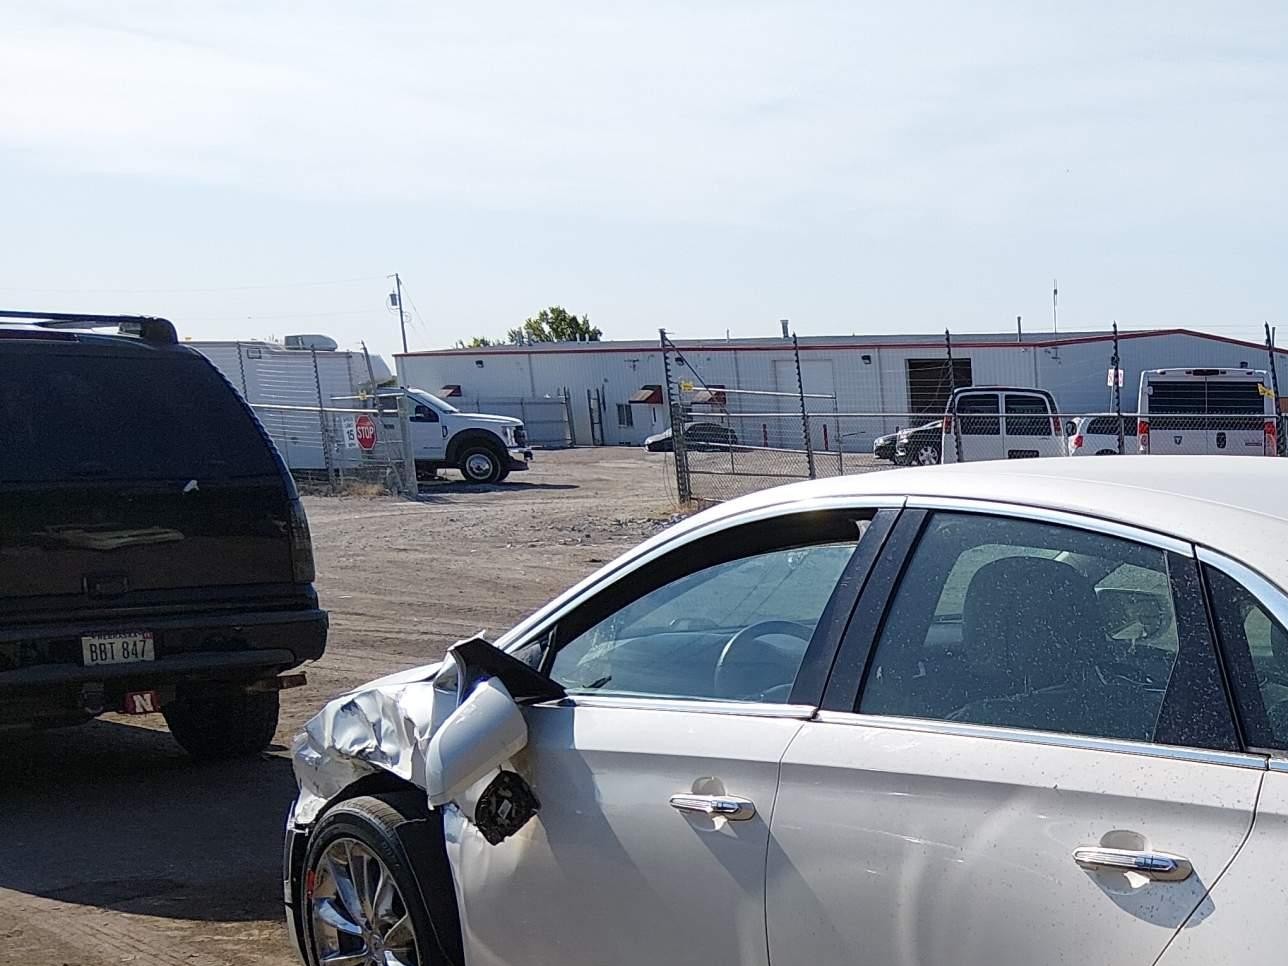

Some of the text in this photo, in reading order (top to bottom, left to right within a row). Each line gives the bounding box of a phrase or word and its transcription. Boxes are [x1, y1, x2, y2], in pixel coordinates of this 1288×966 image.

[347, 429, 355, 441] 15
[357, 426, 374, 439] STOP
[89, 640, 146, 662] BBT 847
[133, 693, 154, 713] N
